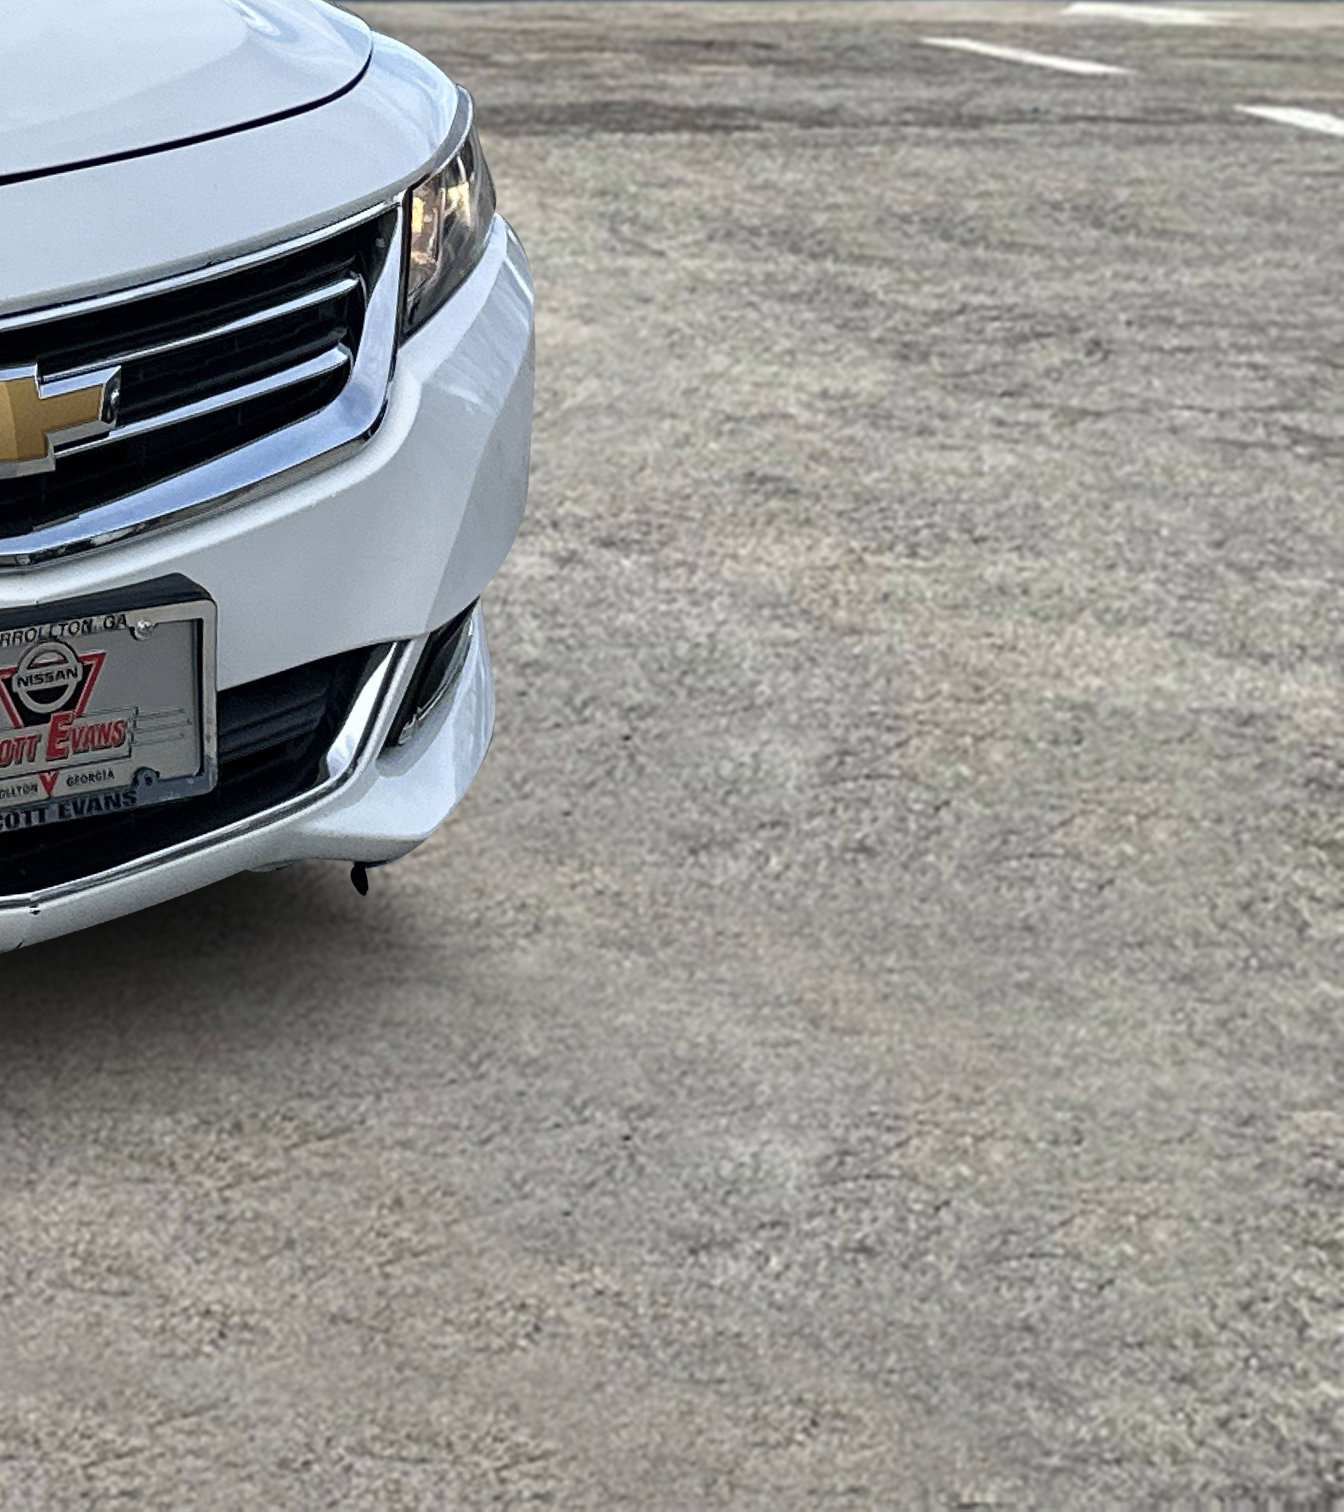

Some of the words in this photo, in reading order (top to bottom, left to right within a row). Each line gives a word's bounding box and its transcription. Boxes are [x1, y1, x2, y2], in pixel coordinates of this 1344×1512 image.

[16, 667, 78, 687] NISSAN
[45, 710, 129, 763] EVANS
[66, 769, 116, 787] GEORGIA
[58, 789, 139, 820] EVANS
